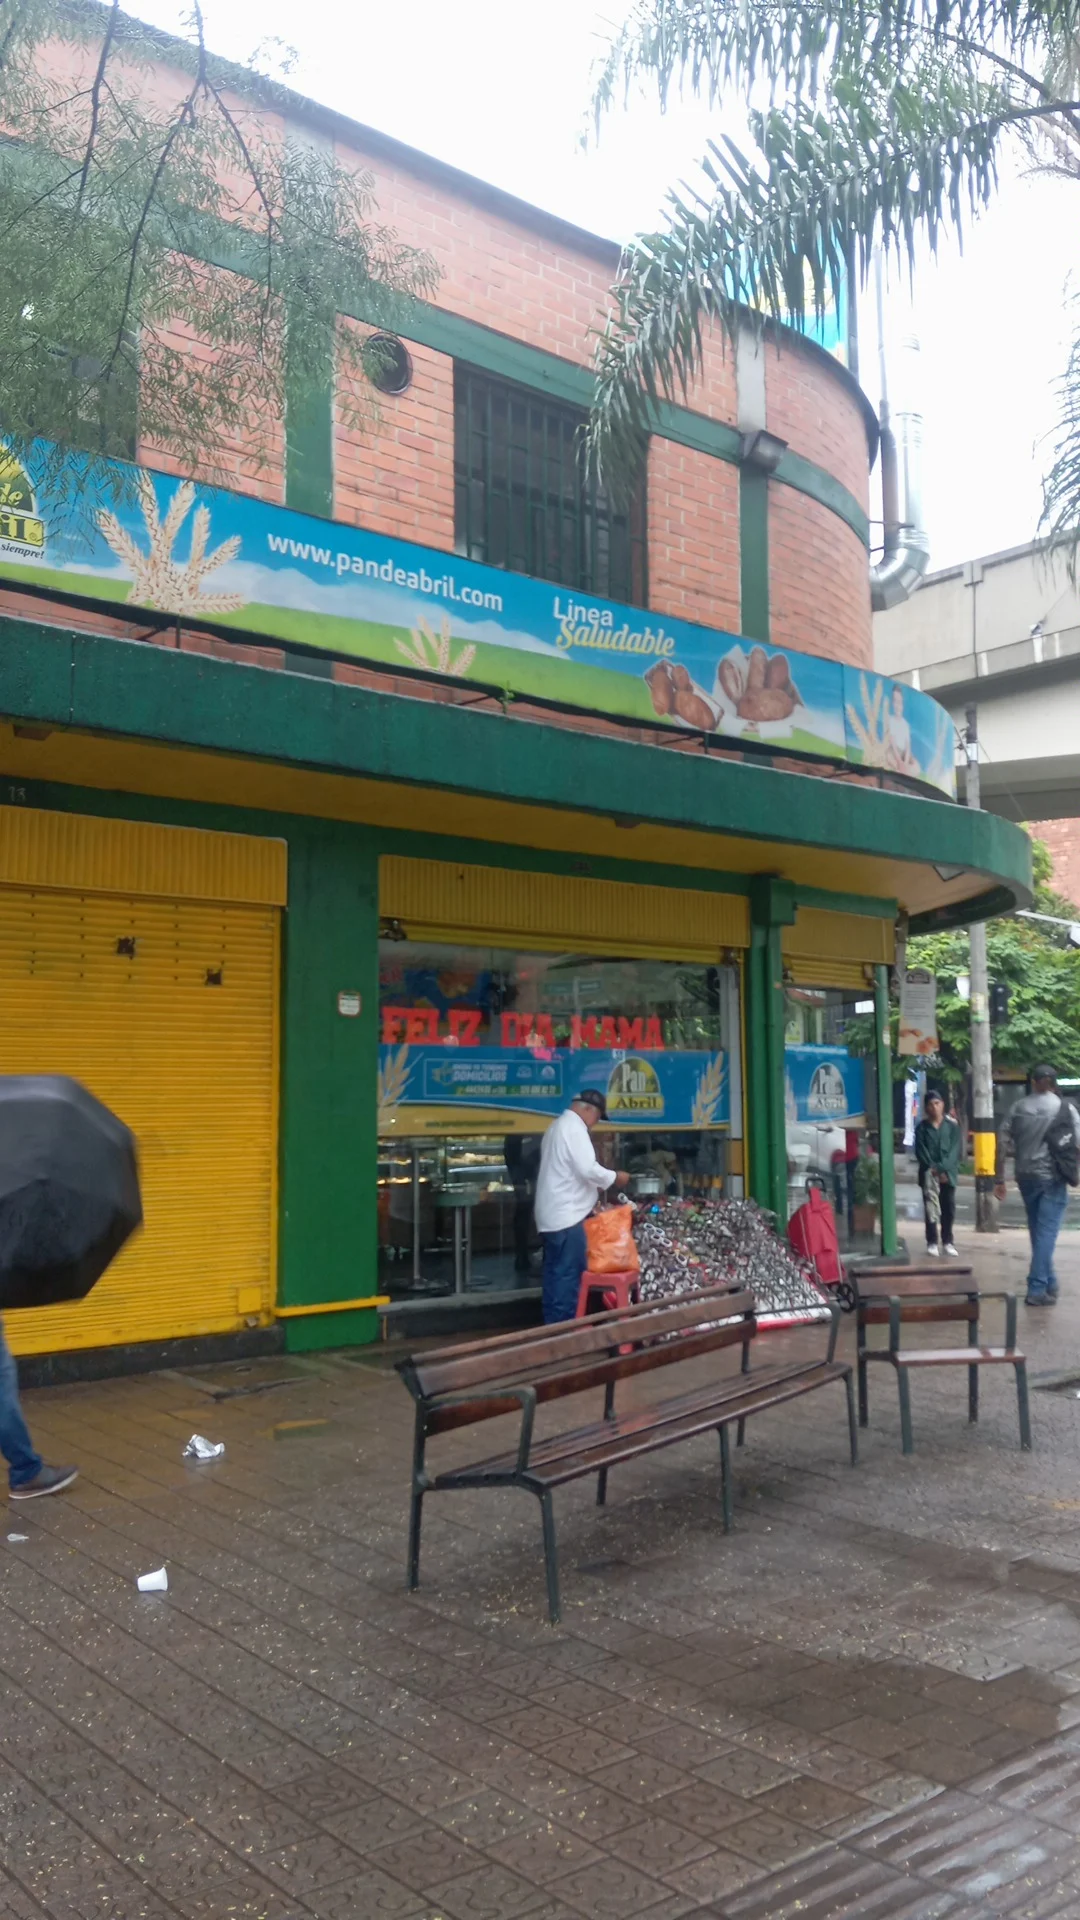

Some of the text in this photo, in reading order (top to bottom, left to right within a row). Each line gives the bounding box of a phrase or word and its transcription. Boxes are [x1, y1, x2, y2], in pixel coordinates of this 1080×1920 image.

[1, 542, 45, 559] siempre!
[267, 533, 503, 612] www.pandeabril.com
[553, 595, 613, 627] Linea
[556, 618, 676, 657] Saludable
[381, 1006, 482, 1046] FELIZ
[622, 1063, 646, 1093] Pan
[614, 1095, 657, 1109] Abril
